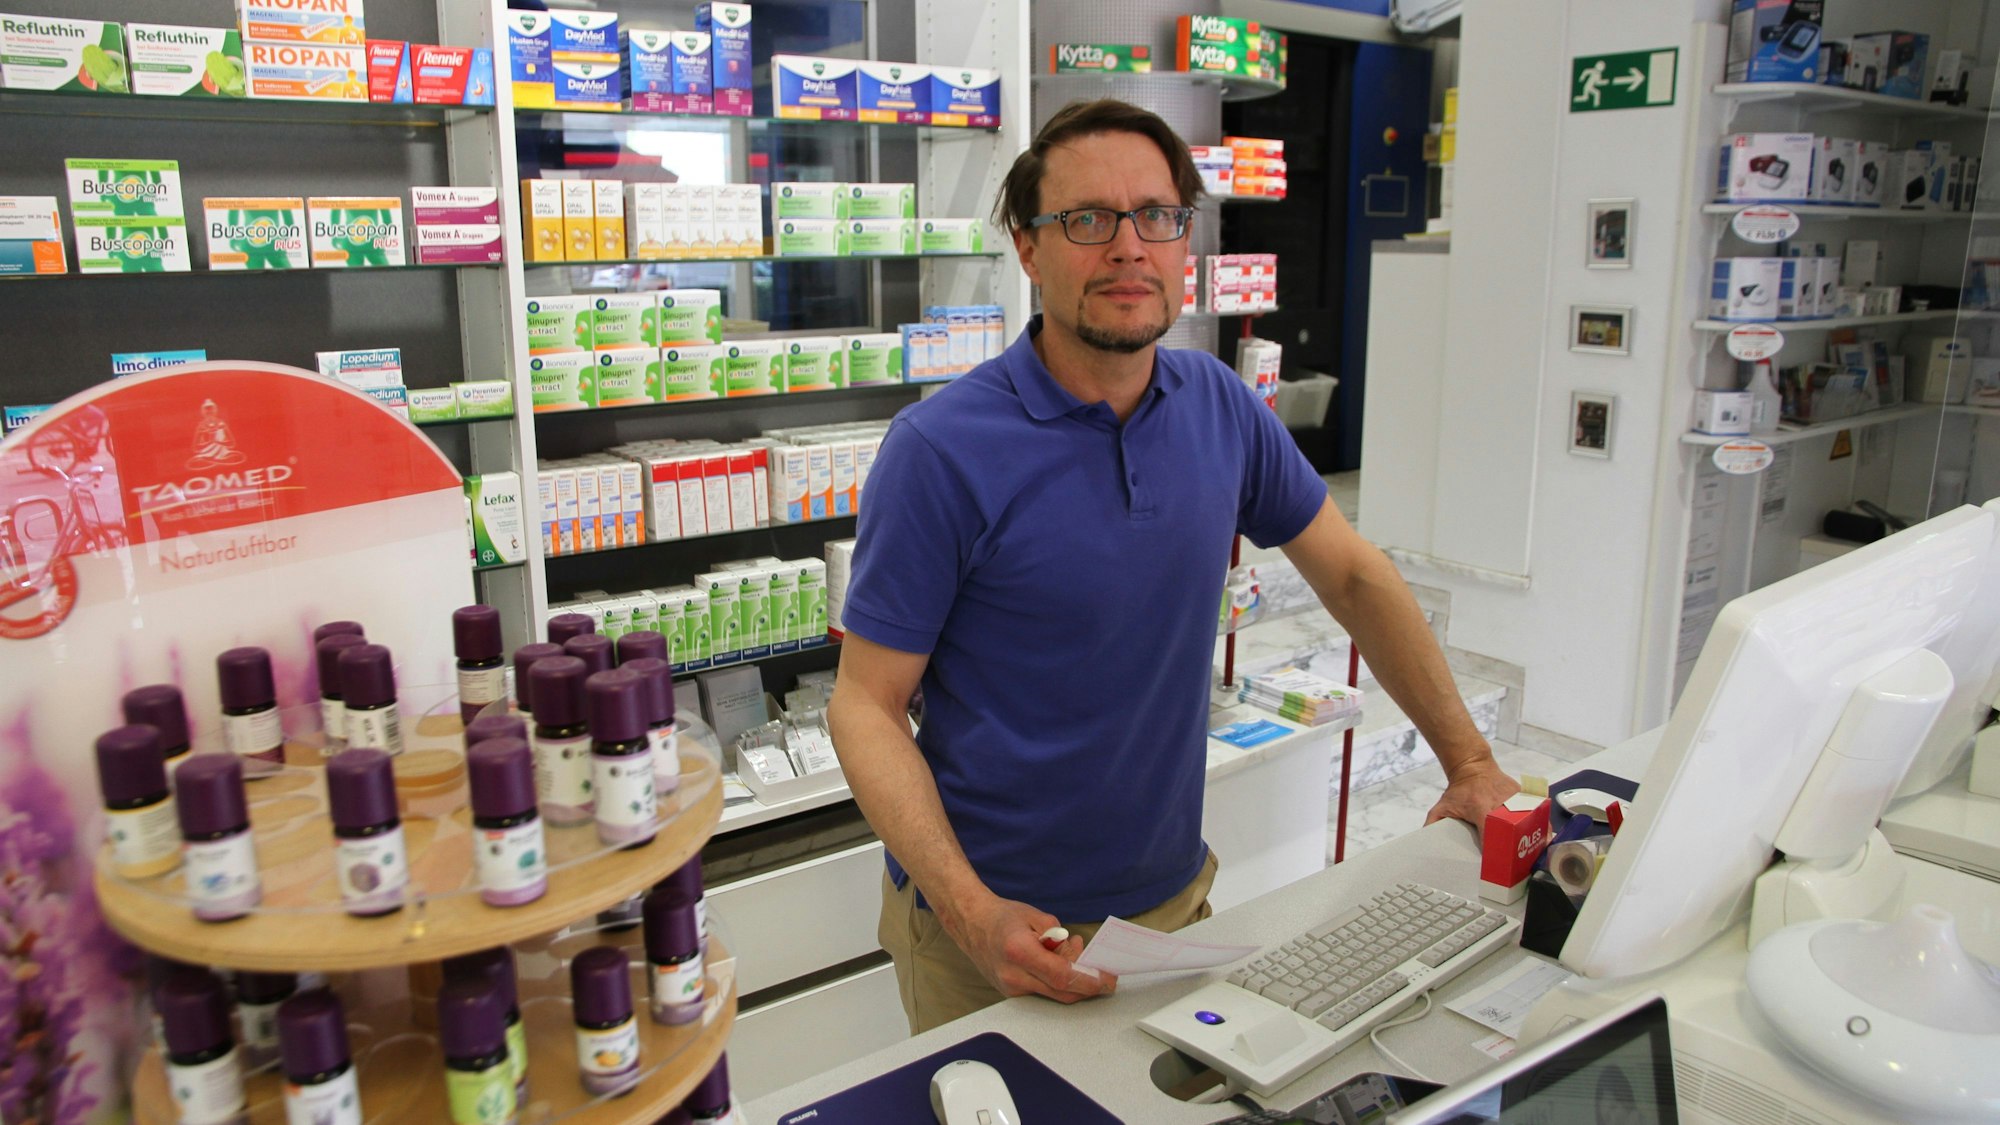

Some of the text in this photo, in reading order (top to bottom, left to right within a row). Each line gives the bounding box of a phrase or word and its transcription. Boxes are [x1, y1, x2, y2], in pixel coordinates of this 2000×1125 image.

[3, 20, 86, 38] Refluthin
[1190, 16, 1227, 38] Kytta
[135, 29, 209, 45] Refluthin
[565, 29, 606, 43] DayMed
[252, 46, 352, 68] RIOPAN
[372, 46, 400, 57] Rennie
[1058, 46, 1104, 66] Kytta
[1190, 45, 1226, 67] Kytta
[423, 50, 465, 66] Rennie
[568, 79, 608, 92] DayMed
[83, 180, 168, 198] Buscopan
[416, 192, 446, 201] Vomex
[449, 192, 456, 200] A
[211, 222, 300, 243] Buscopan
[315, 222, 397, 242] Buscopan
[422, 229, 451, 240] Vomex
[454, 229, 460, 238] A
[91, 237, 174, 255] Buscopan
[275, 239, 301, 250] PLUS
[374, 238, 399, 248] PLUS
[528, 318, 562, 326] Sinupret
[596, 314, 629, 323] Sinupret
[664, 312, 694, 321] Sinupret
[596, 324, 624, 332] extract
[664, 320, 690, 329] extract
[528, 327, 558, 335] extract
[342, 352, 394, 365] Lopedium
[790, 356, 820, 366] Sinupret
[668, 366, 699, 375] Sinupret
[728, 360, 758, 371] Sinupret
[791, 366, 815, 374] extract
[531, 374, 566, 383] Sinupret
[600, 369, 634, 380] Sinupret
[668, 374, 694, 382] extract
[729, 369, 754, 378] extract
[532, 383, 561, 392] extract
[602, 378, 628, 387] extract
[472, 386, 505, 395] Perenterol
[131, 465, 293, 503] TAOMED
[484, 494, 516, 506] Lefax
[160, 534, 297, 574] Naturduftbar
